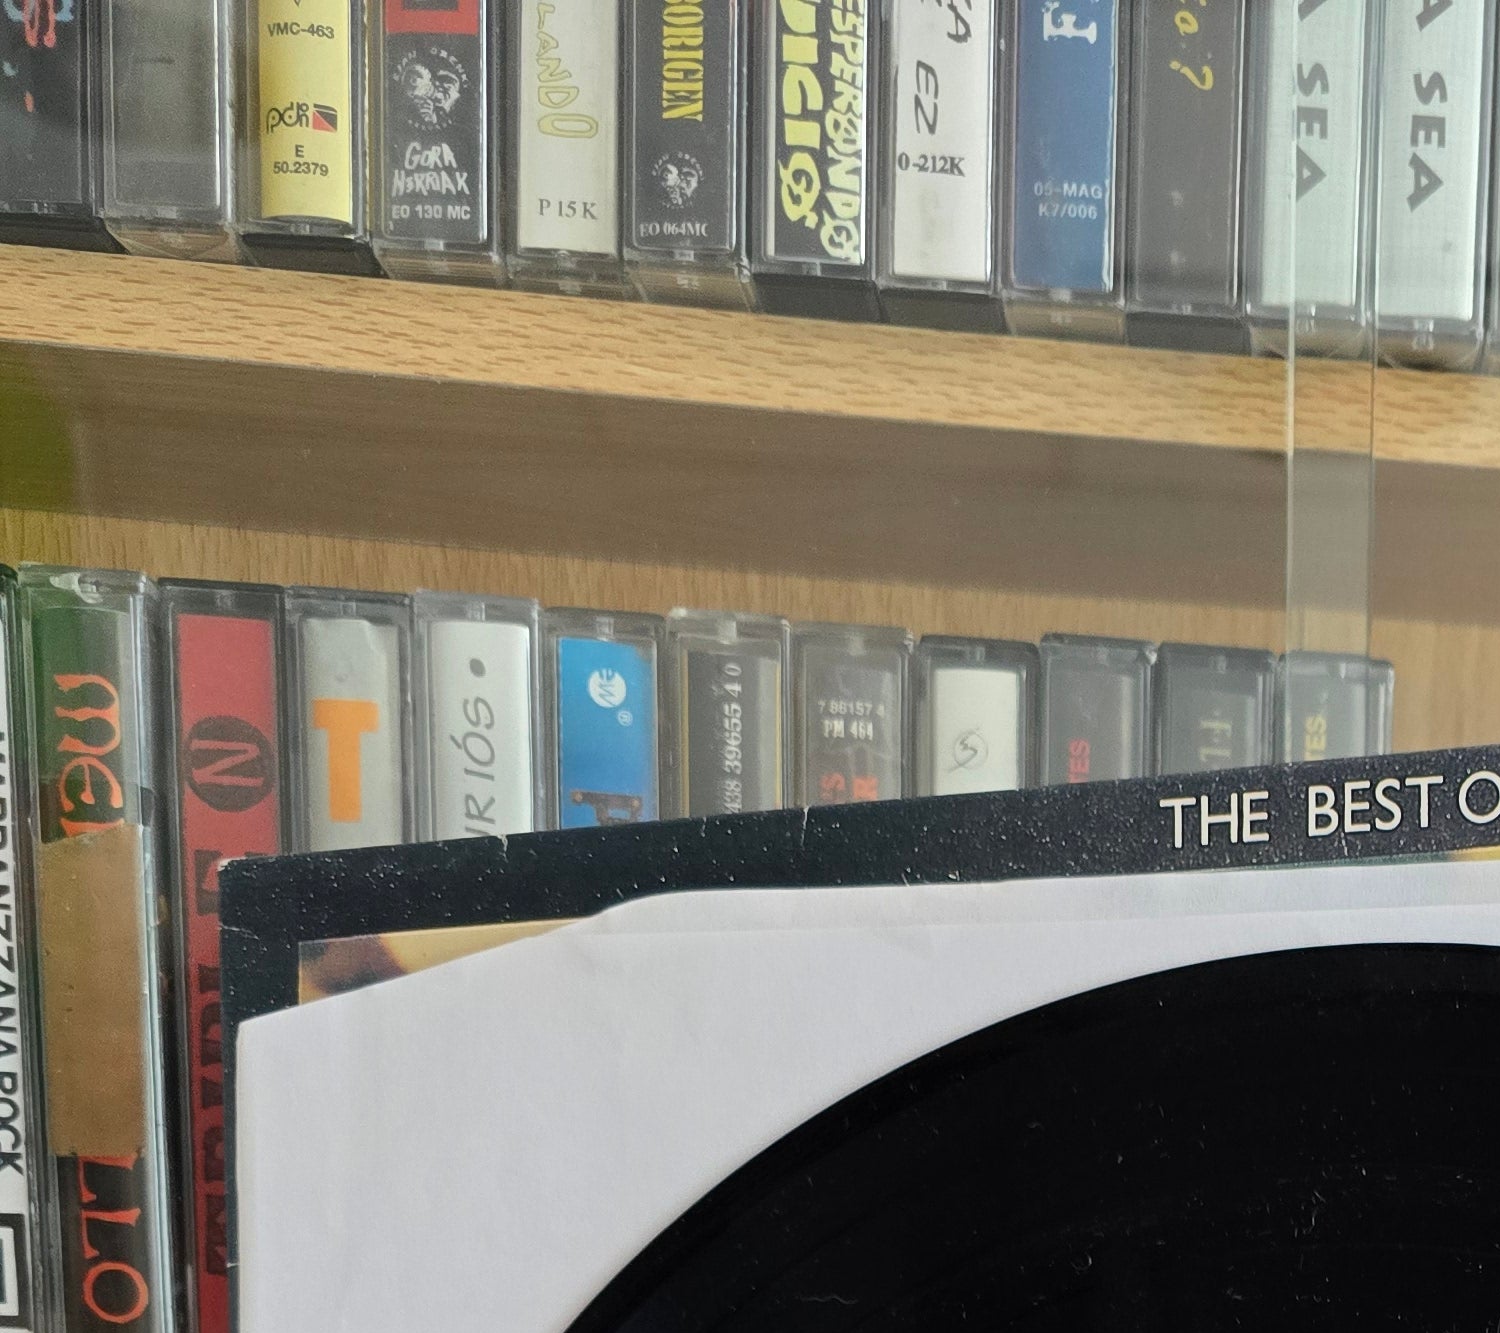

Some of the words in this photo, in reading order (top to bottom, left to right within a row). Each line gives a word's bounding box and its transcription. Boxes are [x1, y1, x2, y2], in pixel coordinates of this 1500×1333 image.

[267, 22, 335, 39] VMC-463
[661, 0, 704, 122] ORIGEN
[294, 144, 305, 158] E
[1406, 71, 1448, 213] SEA
[273, 161, 329, 177] 50.2379
[414, 205, 443, 219] 130
[447, 205, 471, 220] MC
[538, 198, 551, 217] P
[557, 200, 577, 219] 15
[582, 202, 599, 220] K
[1159, 791, 1270, 849] THE
[1307, 774, 1444, 838] BEST
